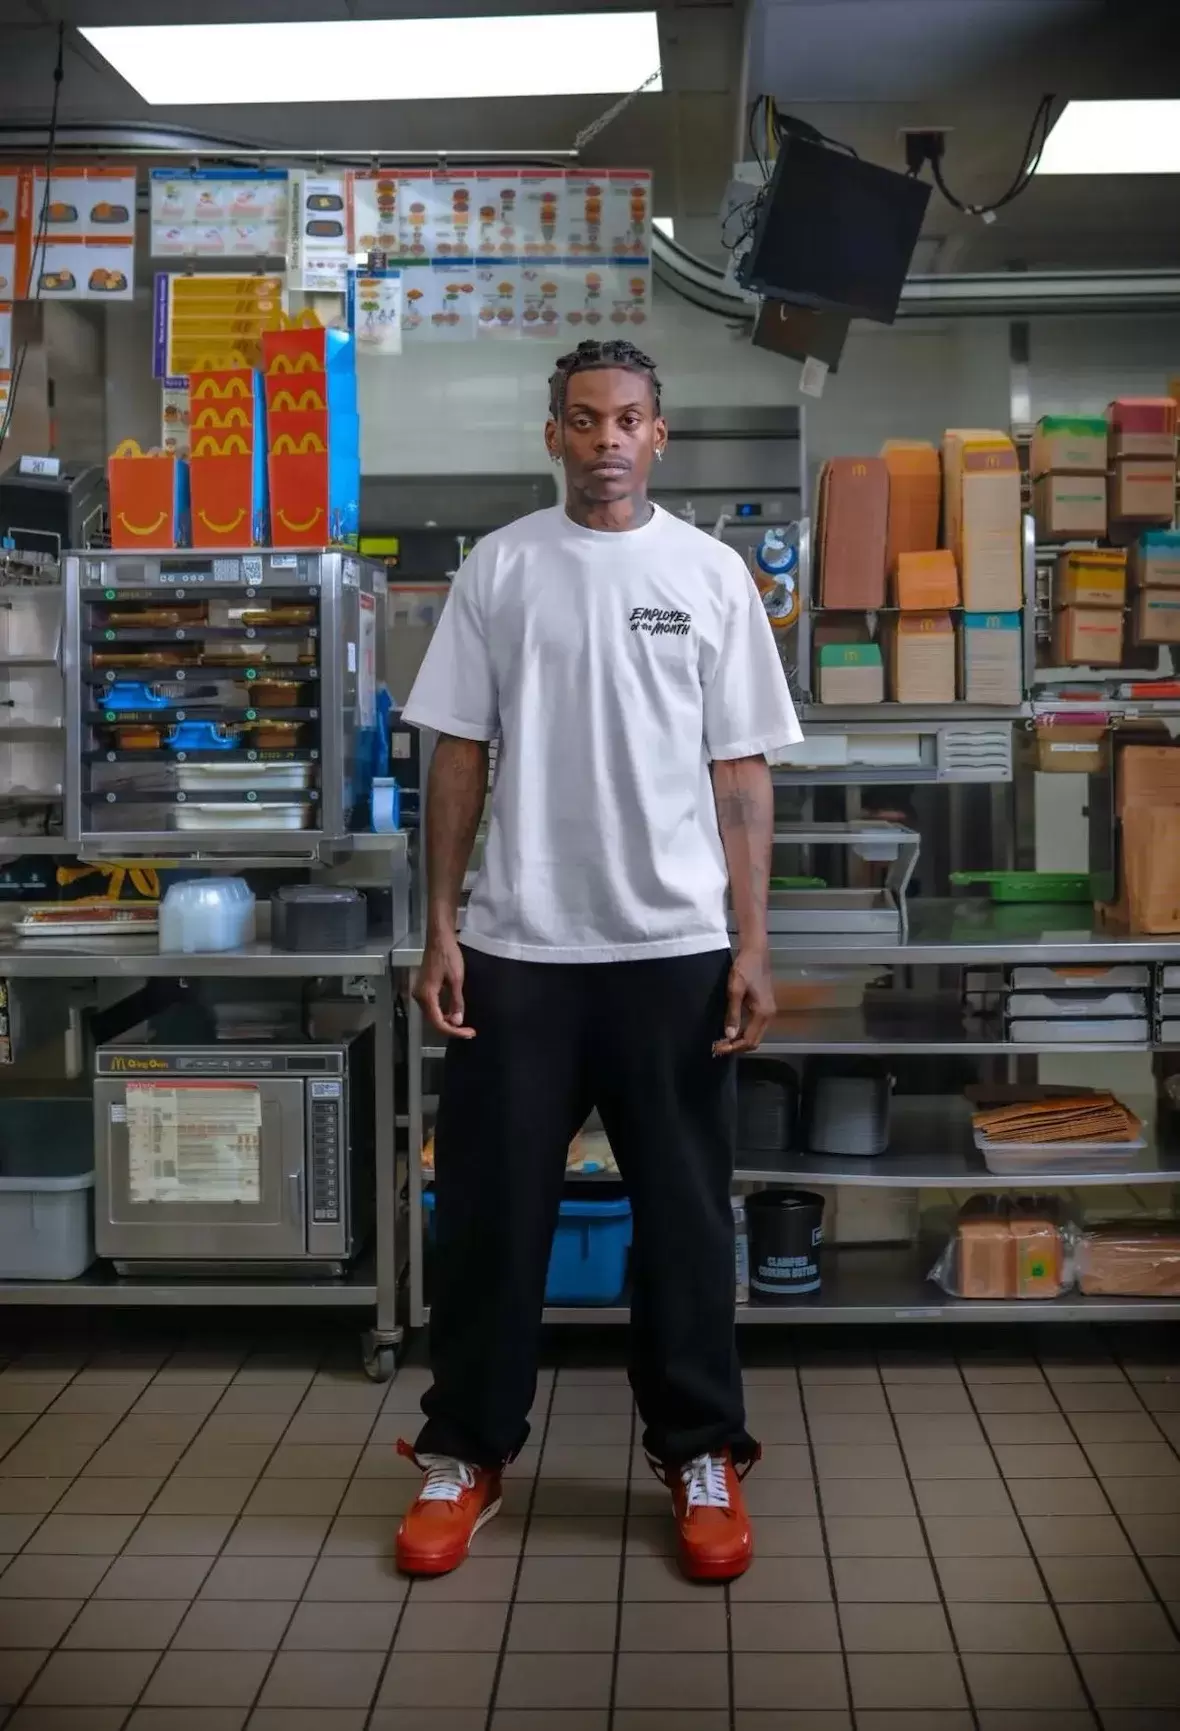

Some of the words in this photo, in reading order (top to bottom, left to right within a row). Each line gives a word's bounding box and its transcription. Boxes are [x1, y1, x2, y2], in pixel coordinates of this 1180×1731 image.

[629, 607, 691, 622] EMPLOYEE
[630, 621, 640, 631] of
[651, 622, 690, 636] MONTH
